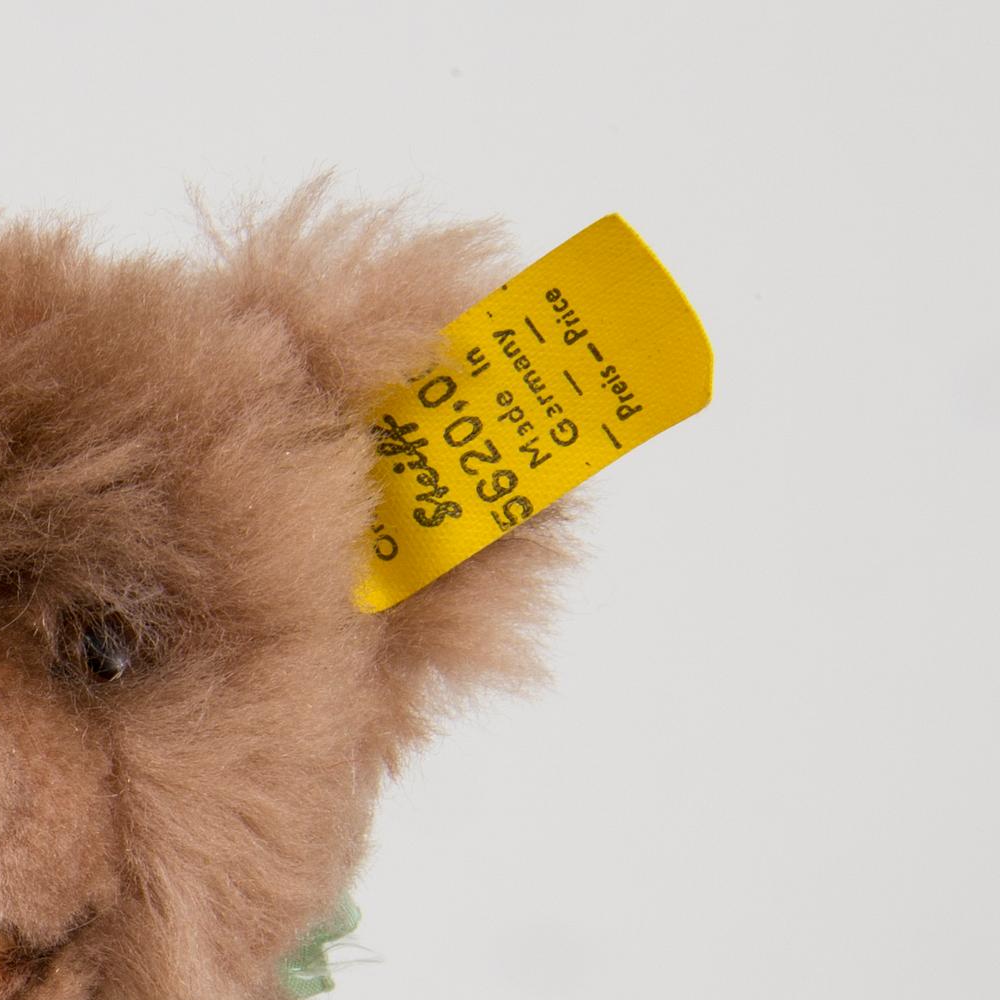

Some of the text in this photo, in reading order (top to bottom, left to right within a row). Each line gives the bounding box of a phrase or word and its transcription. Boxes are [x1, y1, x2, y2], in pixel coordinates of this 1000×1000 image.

[545, 287, 589, 346] Price
[493, 328, 579, 448] Germany
[497, 390, 552, 469] Made
[600, 364, 644, 421] Preis
[371, 414, 462, 528] Steiff
[407, 366, 534, 532] 5620,0
